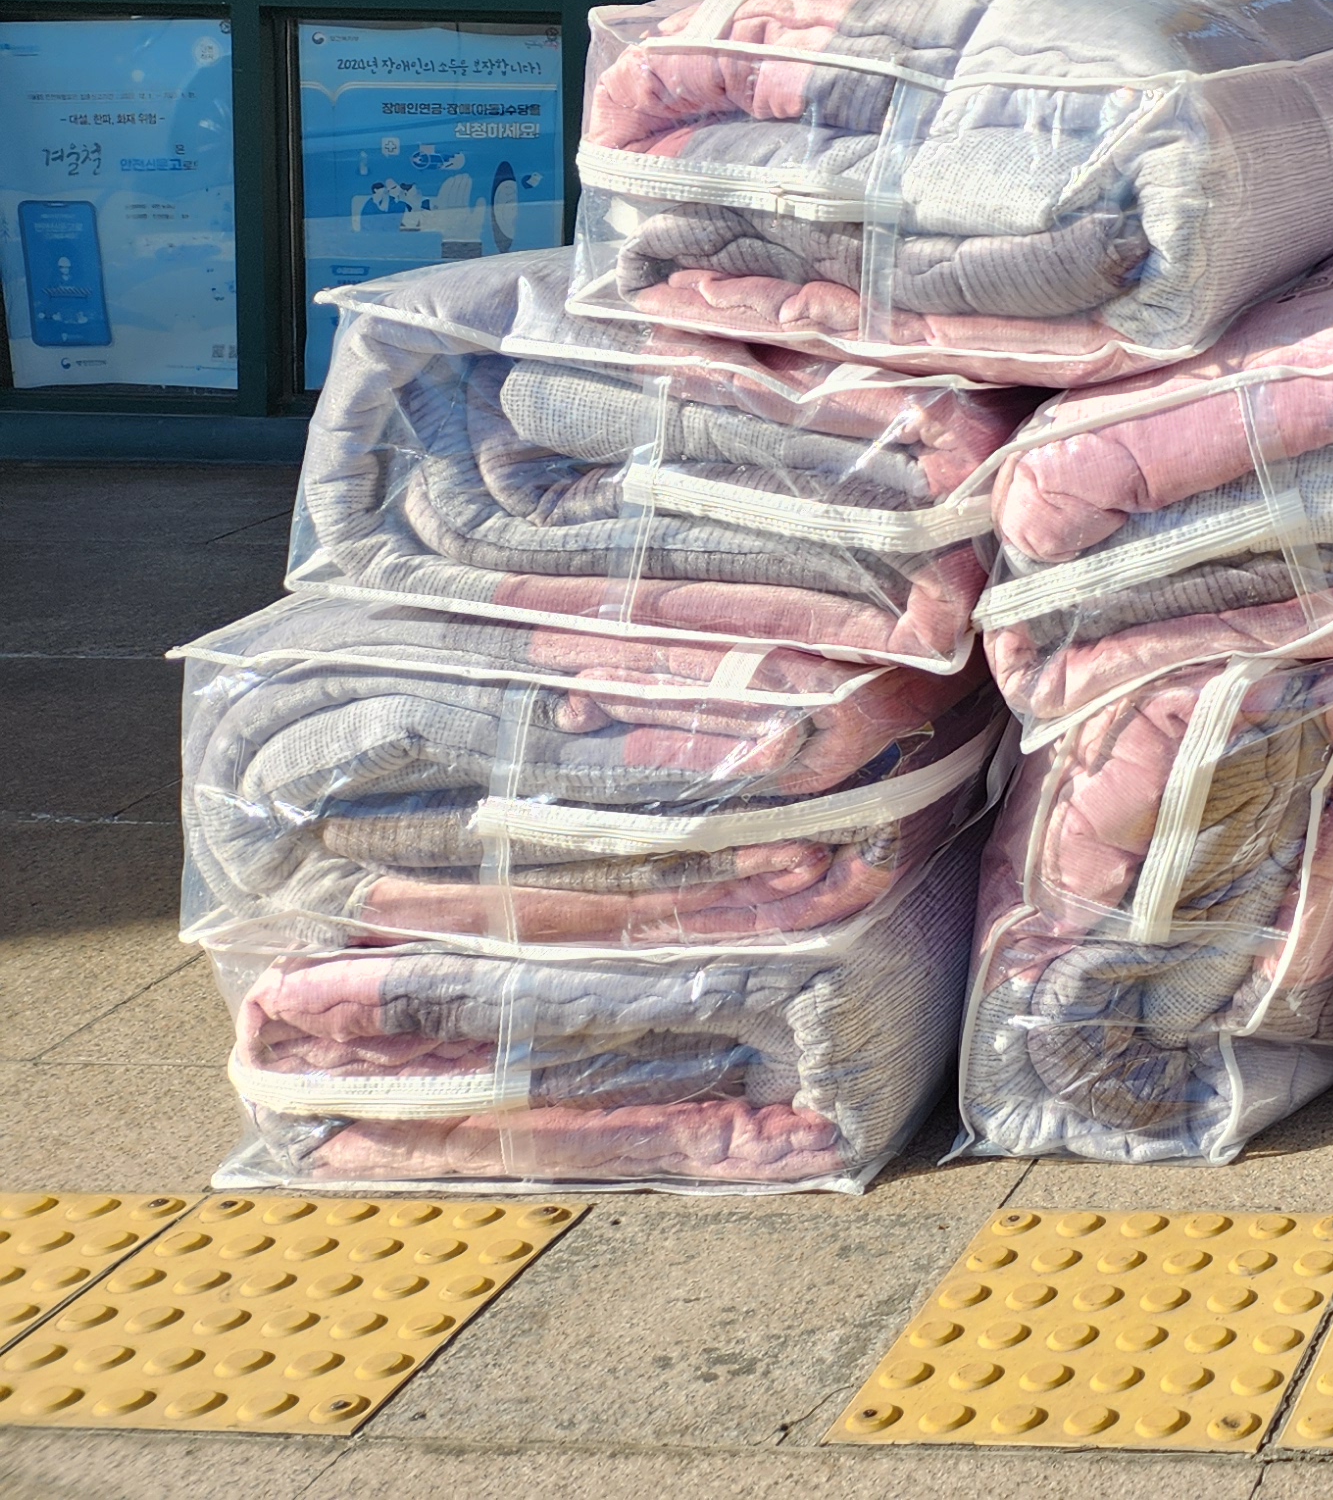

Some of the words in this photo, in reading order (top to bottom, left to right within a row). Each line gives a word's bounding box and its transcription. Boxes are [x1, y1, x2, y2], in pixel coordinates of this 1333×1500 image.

[381, 56, 436, 75] 장애인의
[437, 57, 470, 77] 소득을
[472, 57, 542, 77] 보장합니다!
[93, 113, 115, 126] 한파,
[116, 113, 136, 125] 화재
[454, 122, 541, 140] 신청하세요!
